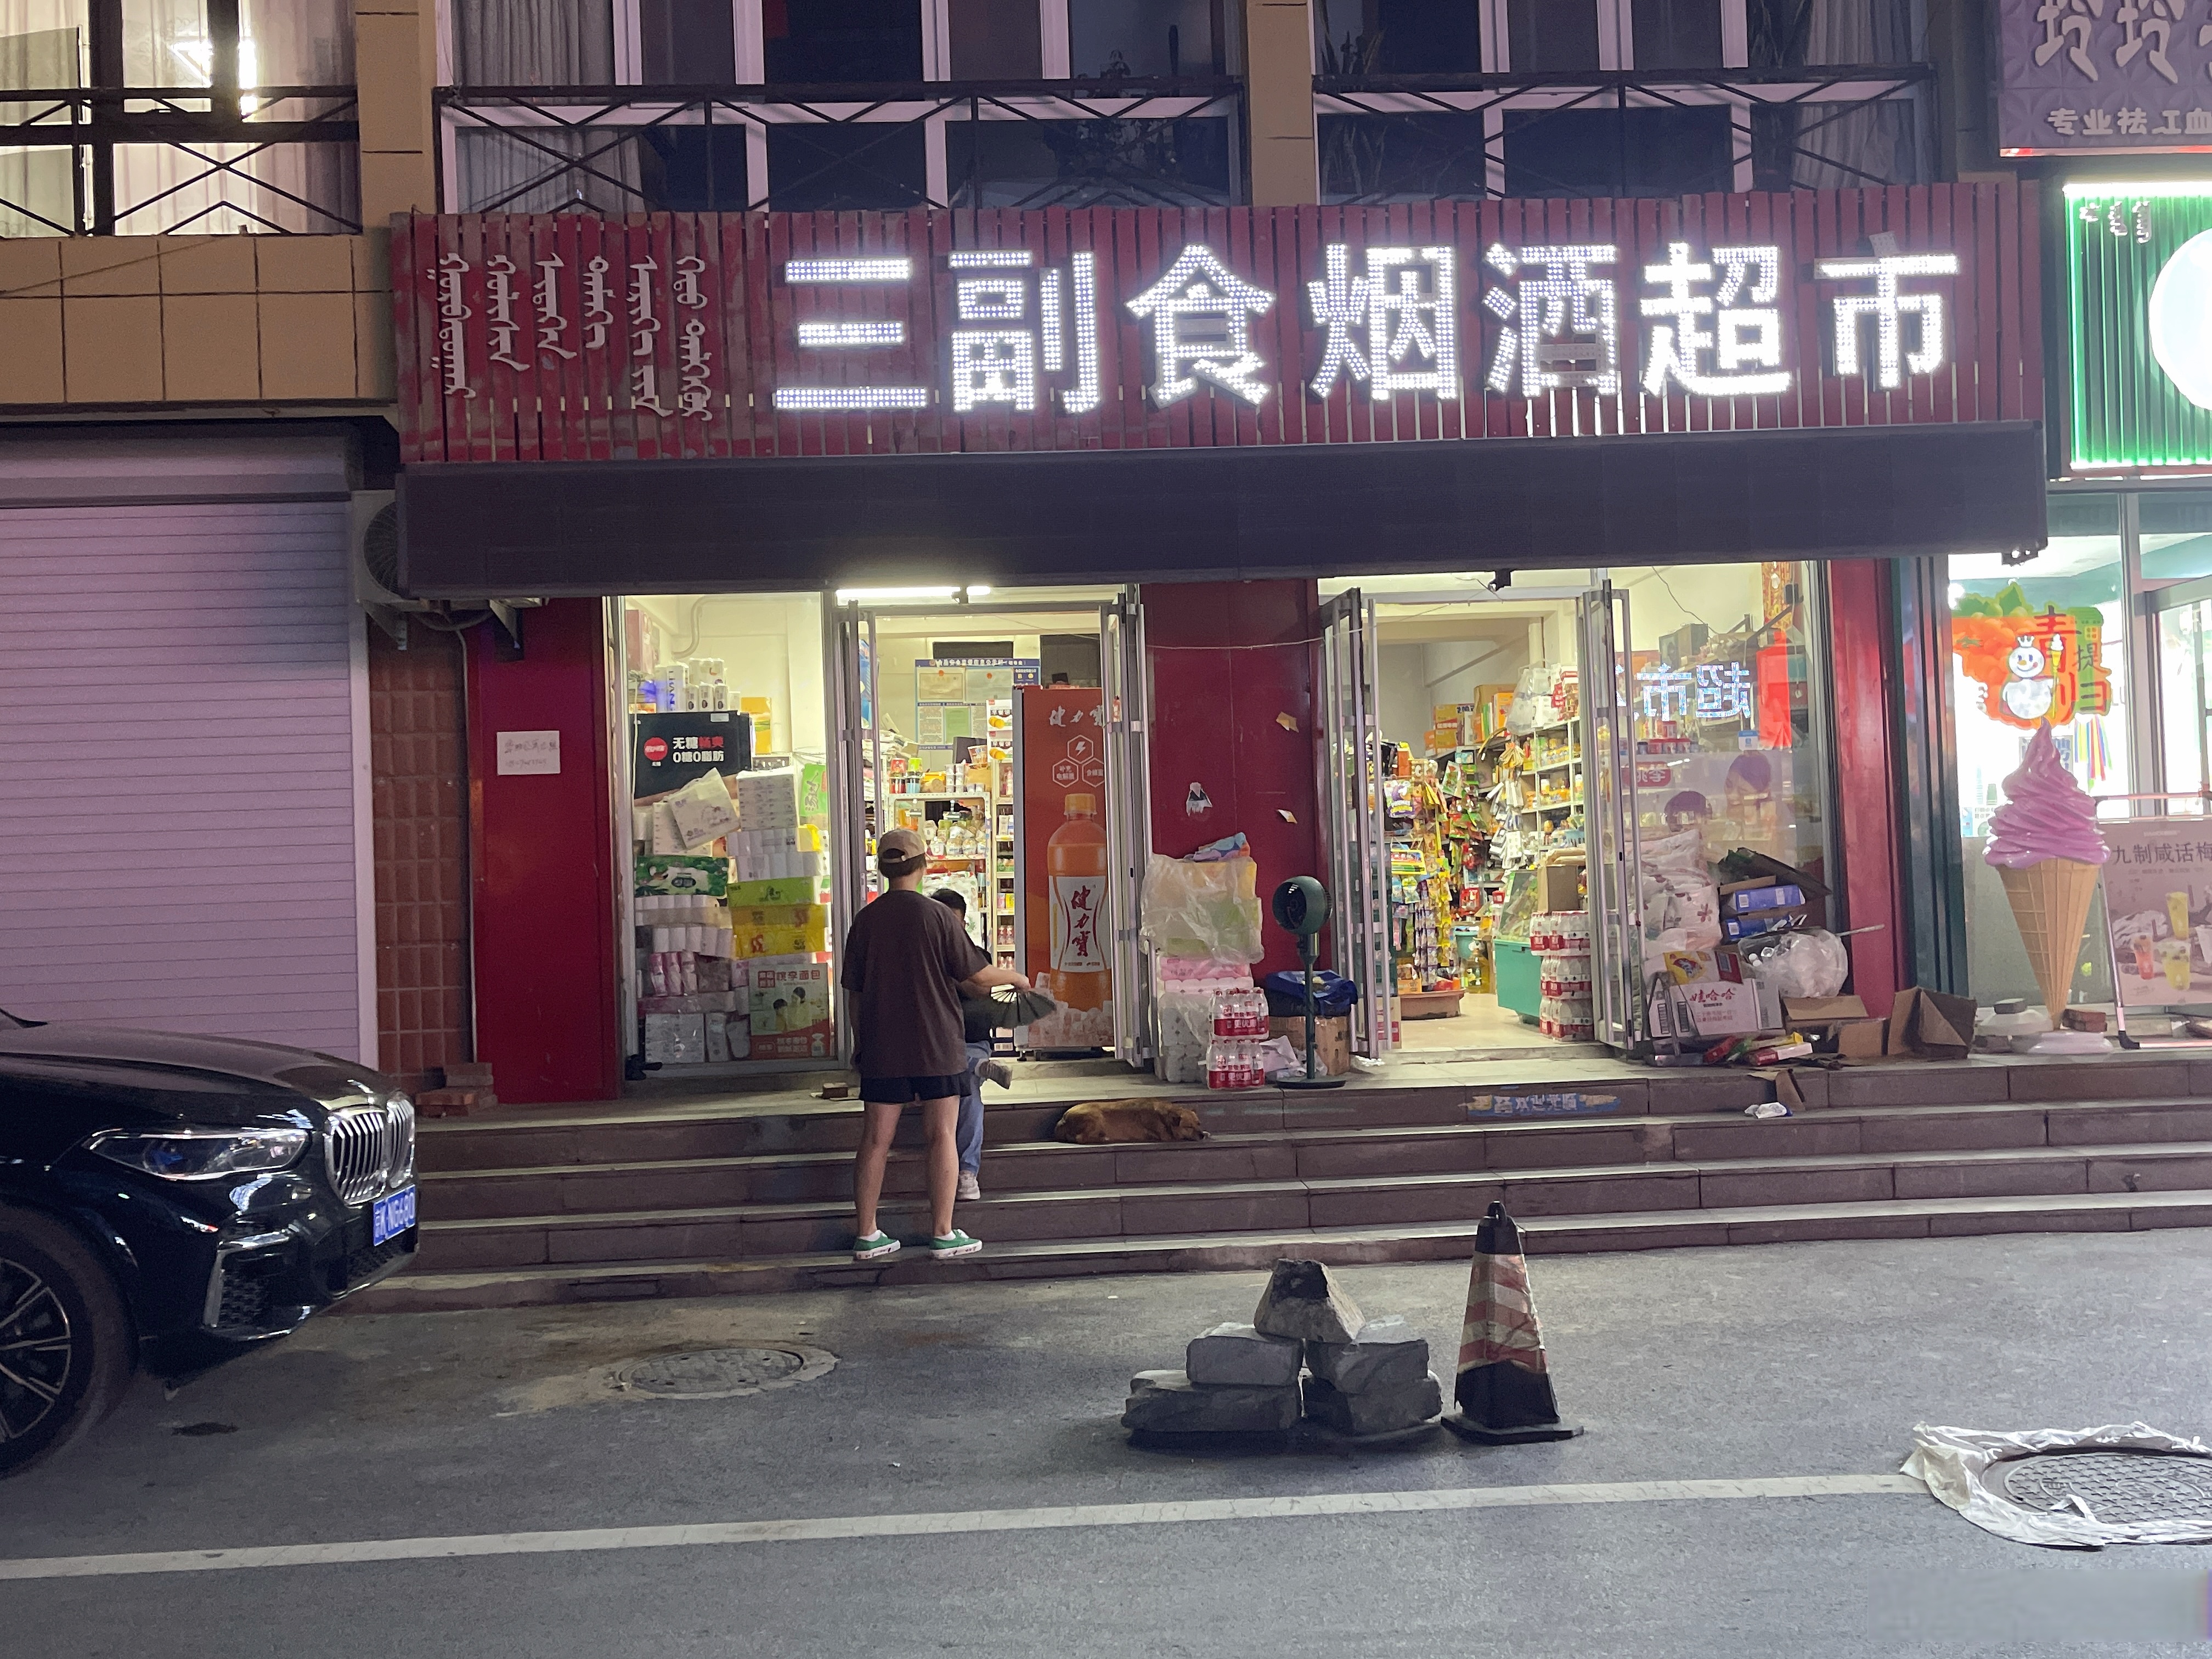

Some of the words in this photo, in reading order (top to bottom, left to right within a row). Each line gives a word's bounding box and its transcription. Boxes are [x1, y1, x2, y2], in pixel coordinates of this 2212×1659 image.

[775, 232, 1959, 414] 三副食烟酒超市
